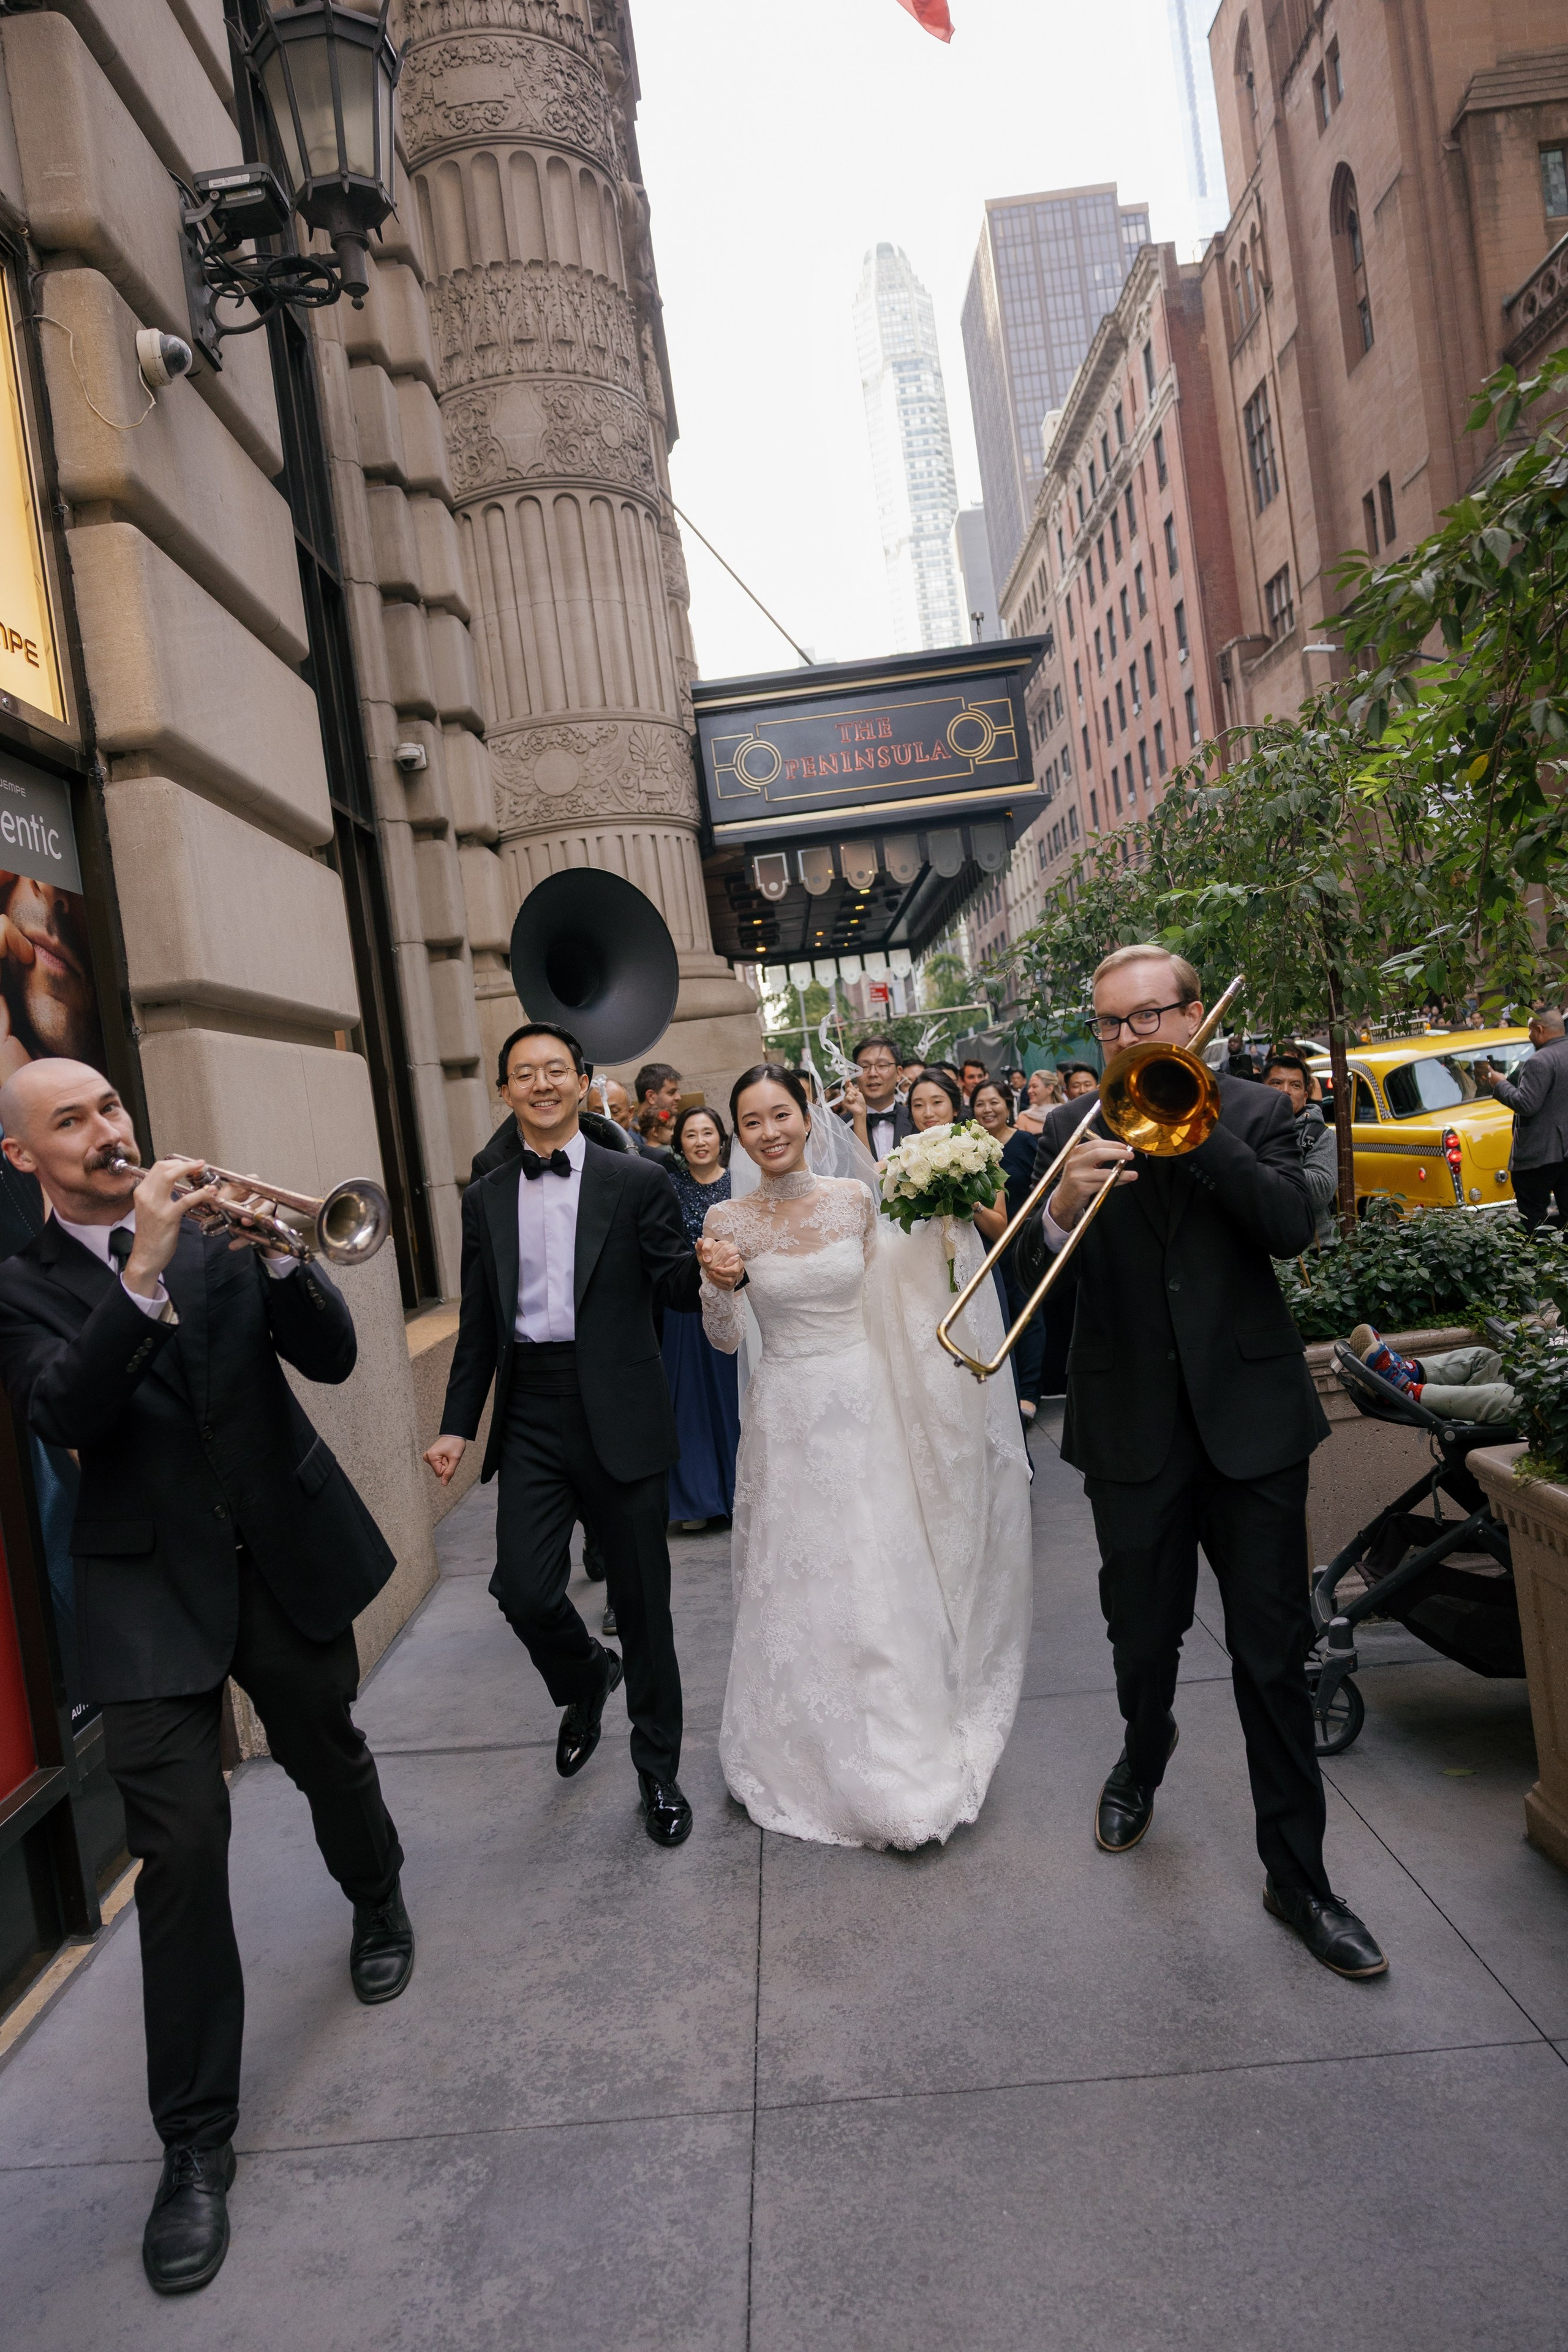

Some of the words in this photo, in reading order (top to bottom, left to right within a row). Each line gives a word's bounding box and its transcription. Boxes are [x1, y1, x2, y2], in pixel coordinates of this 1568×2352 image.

[835, 717, 892, 743] THE
[783, 739, 952, 780] PENINSULA
[72, 1704, 89, 1721] AU
